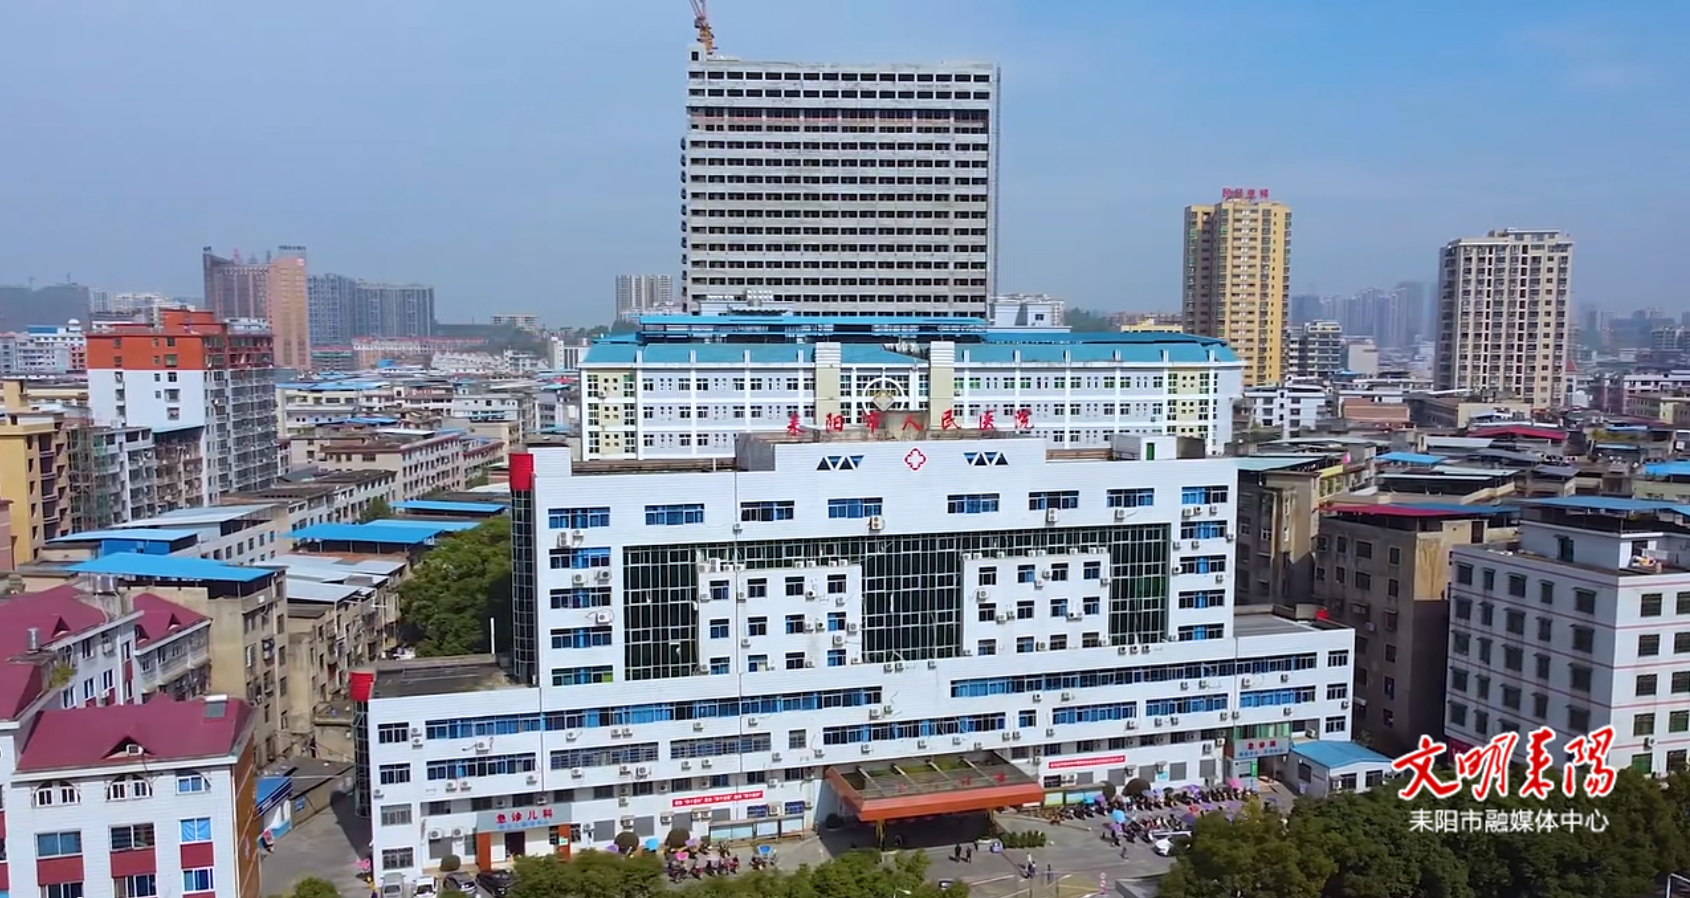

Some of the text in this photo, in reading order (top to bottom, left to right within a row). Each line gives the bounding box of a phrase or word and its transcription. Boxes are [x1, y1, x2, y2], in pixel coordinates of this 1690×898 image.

[786, 409, 1035, 436] 耒阳市人民医院
[496, 808, 553, 824] 急诊儿科
